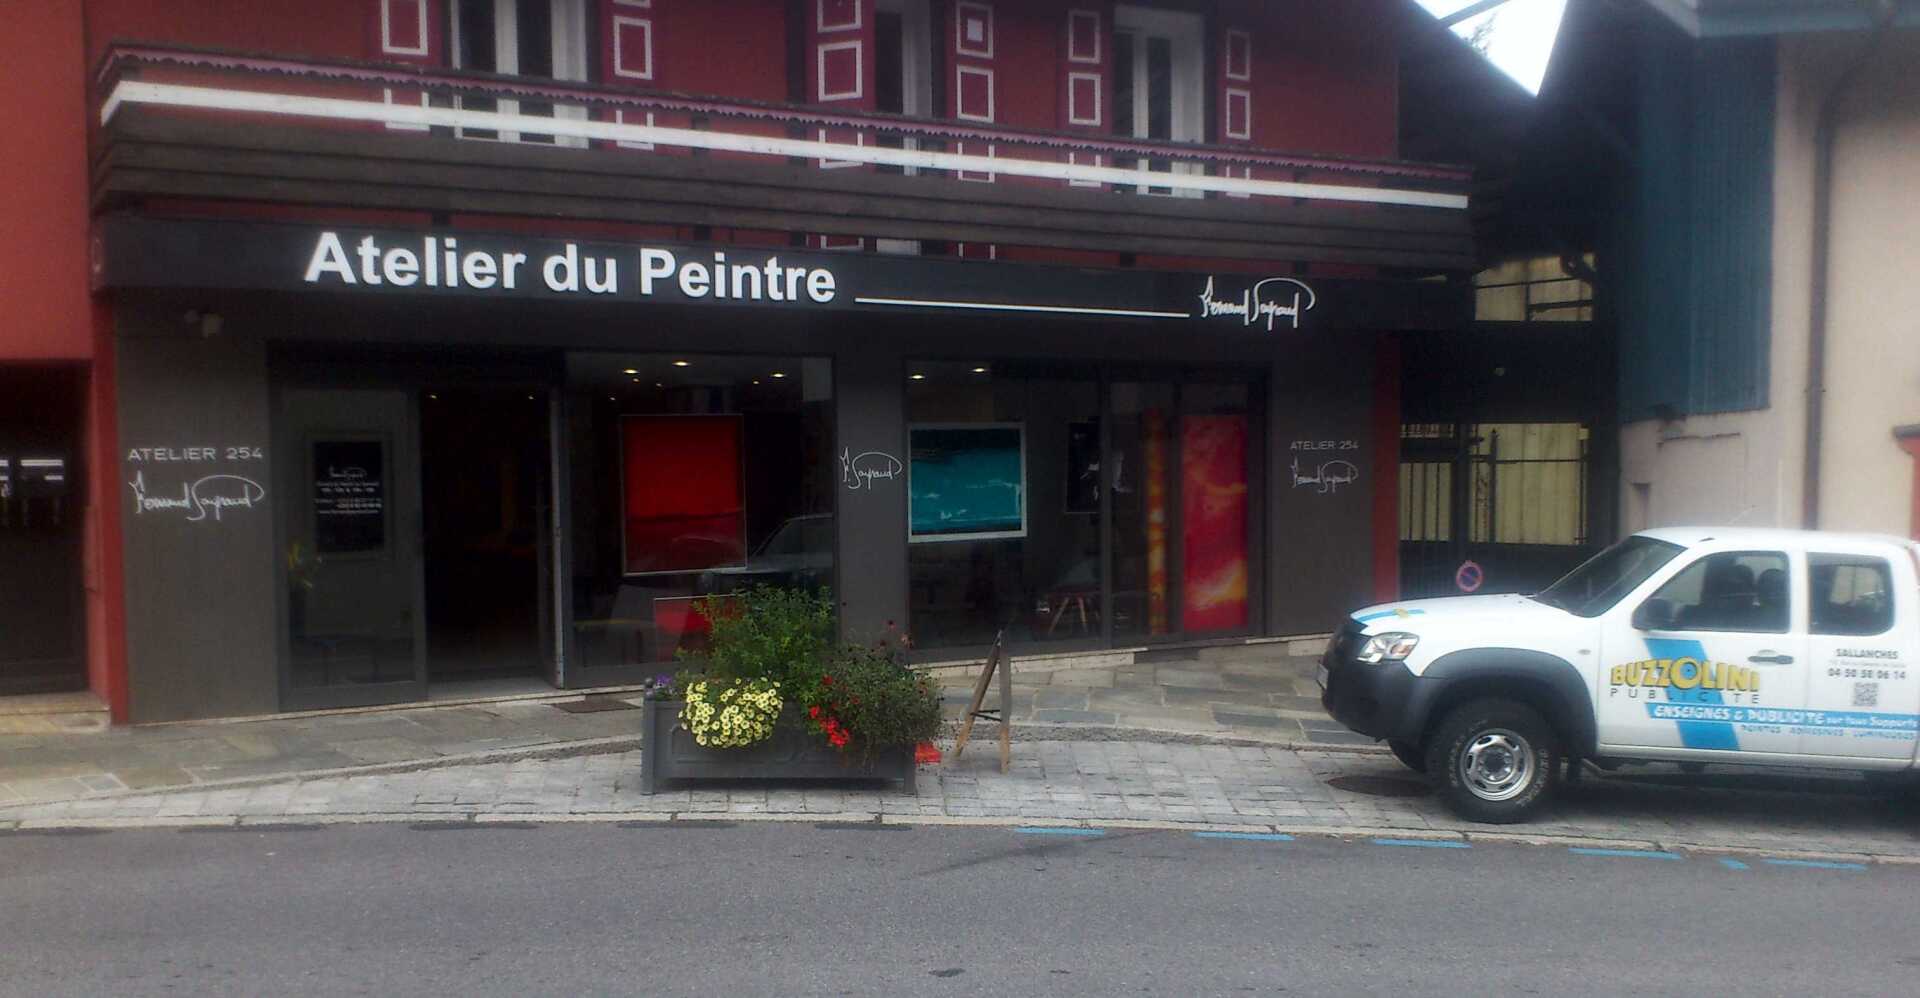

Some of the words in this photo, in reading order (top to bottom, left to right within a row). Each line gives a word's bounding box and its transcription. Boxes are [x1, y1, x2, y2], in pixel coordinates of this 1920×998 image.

[304, 231, 527, 290] Atelier
[543, 244, 618, 294] du
[640, 247, 836, 303] Peintre
[1290, 440, 1337, 450] ATELIER
[1339, 440, 1359, 449] 254
[128, 447, 216, 461] ATELIER
[226, 446, 264, 460] 254
[1835, 648, 1899, 660] SALLANCHES
[1610, 656, 1760, 692] BUZZOLINI
[1828, 667, 1841, 677] 04
[1893, 670, 1906, 680] 14
